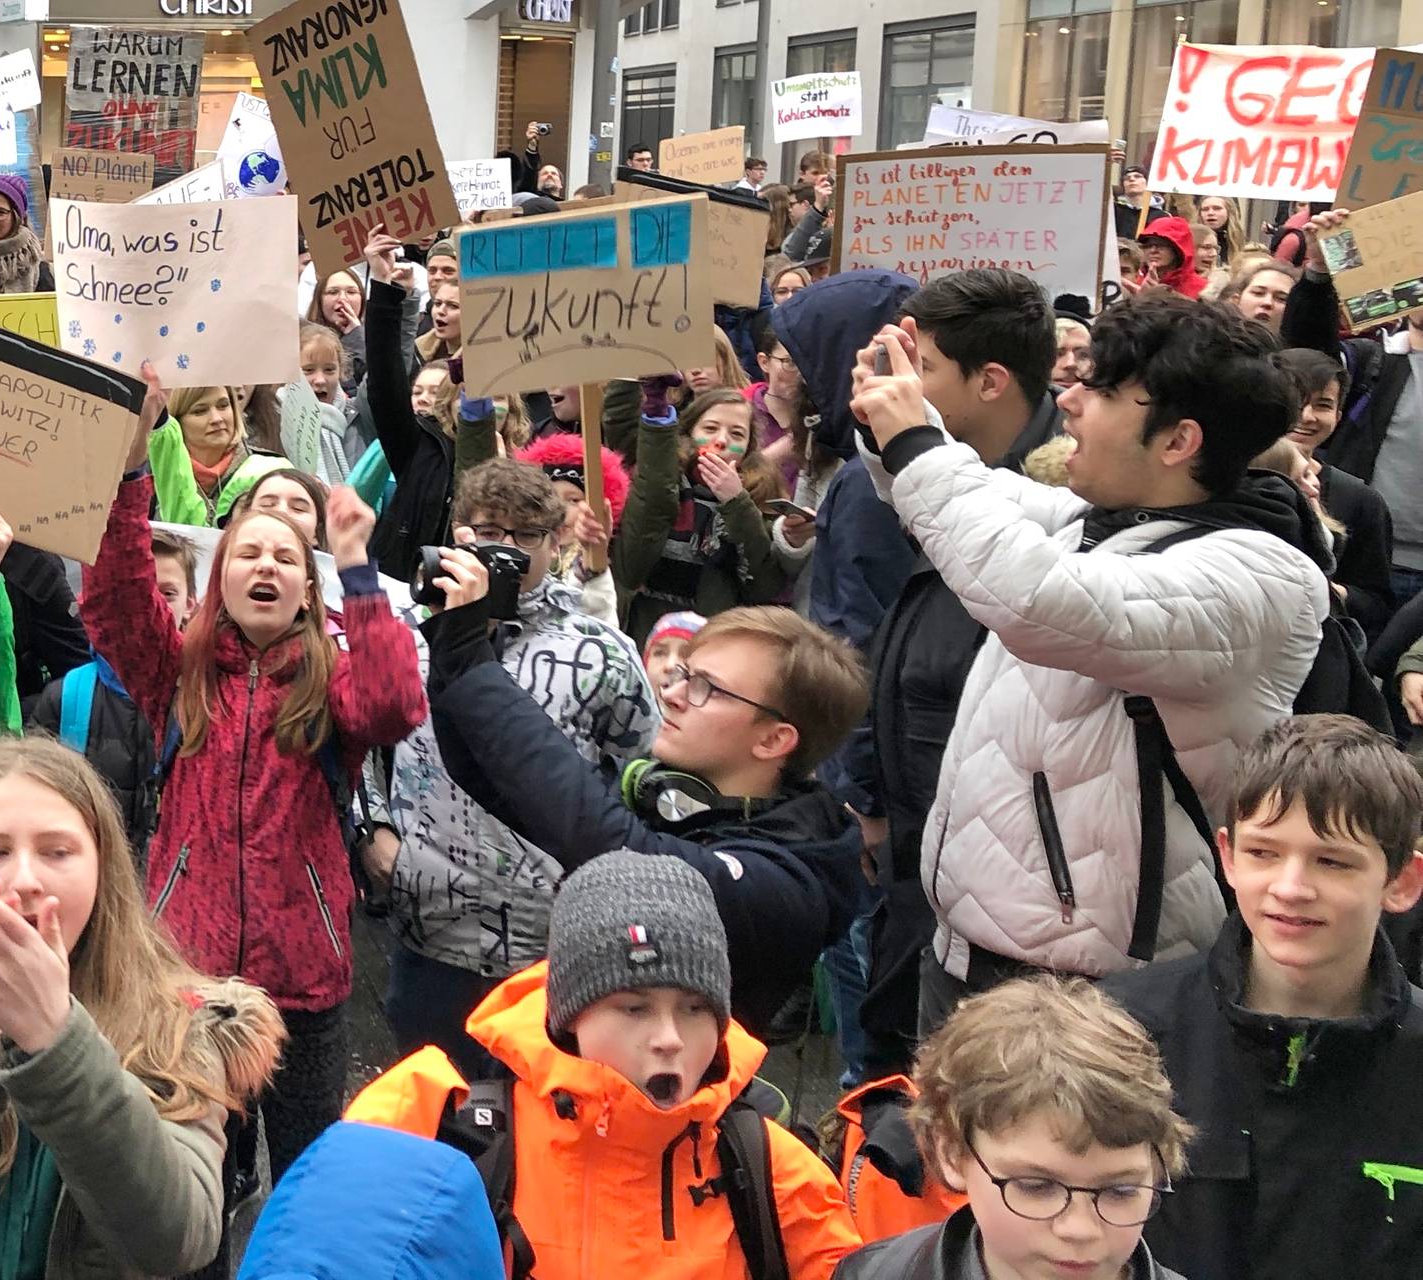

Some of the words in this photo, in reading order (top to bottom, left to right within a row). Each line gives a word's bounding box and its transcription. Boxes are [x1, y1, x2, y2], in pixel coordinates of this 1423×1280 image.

[92, 31, 184, 56] WARUM
[72, 57, 199, 98] LERNEN
[281, 33, 388, 128] KLIMA
[800, 89, 829, 103] statt
[322, 106, 378, 161] FÜR
[94, 155, 148, 184] Planet
[309, 148, 436, 230] TOLERANZ
[856, 166, 870, 185] Es
[881, 163, 902, 184] ist
[993, 160, 1033, 177] den
[853, 182, 993, 208] PLANETEN
[998, 179, 1092, 205] JETZT
[122, 231, 178, 253] was
[189, 208, 225, 254] ist
[467, 223, 601, 273] RETTET
[633, 206, 685, 266] DIE
[848, 235, 893, 255] ALS
[906, 233, 947, 253] IHN
[960, 227, 1058, 252] SPÄTER
[853, 215, 876, 234] zu
[466, 263, 691, 347] Zukunft!
[0, 400, 62, 442] WITZ!
